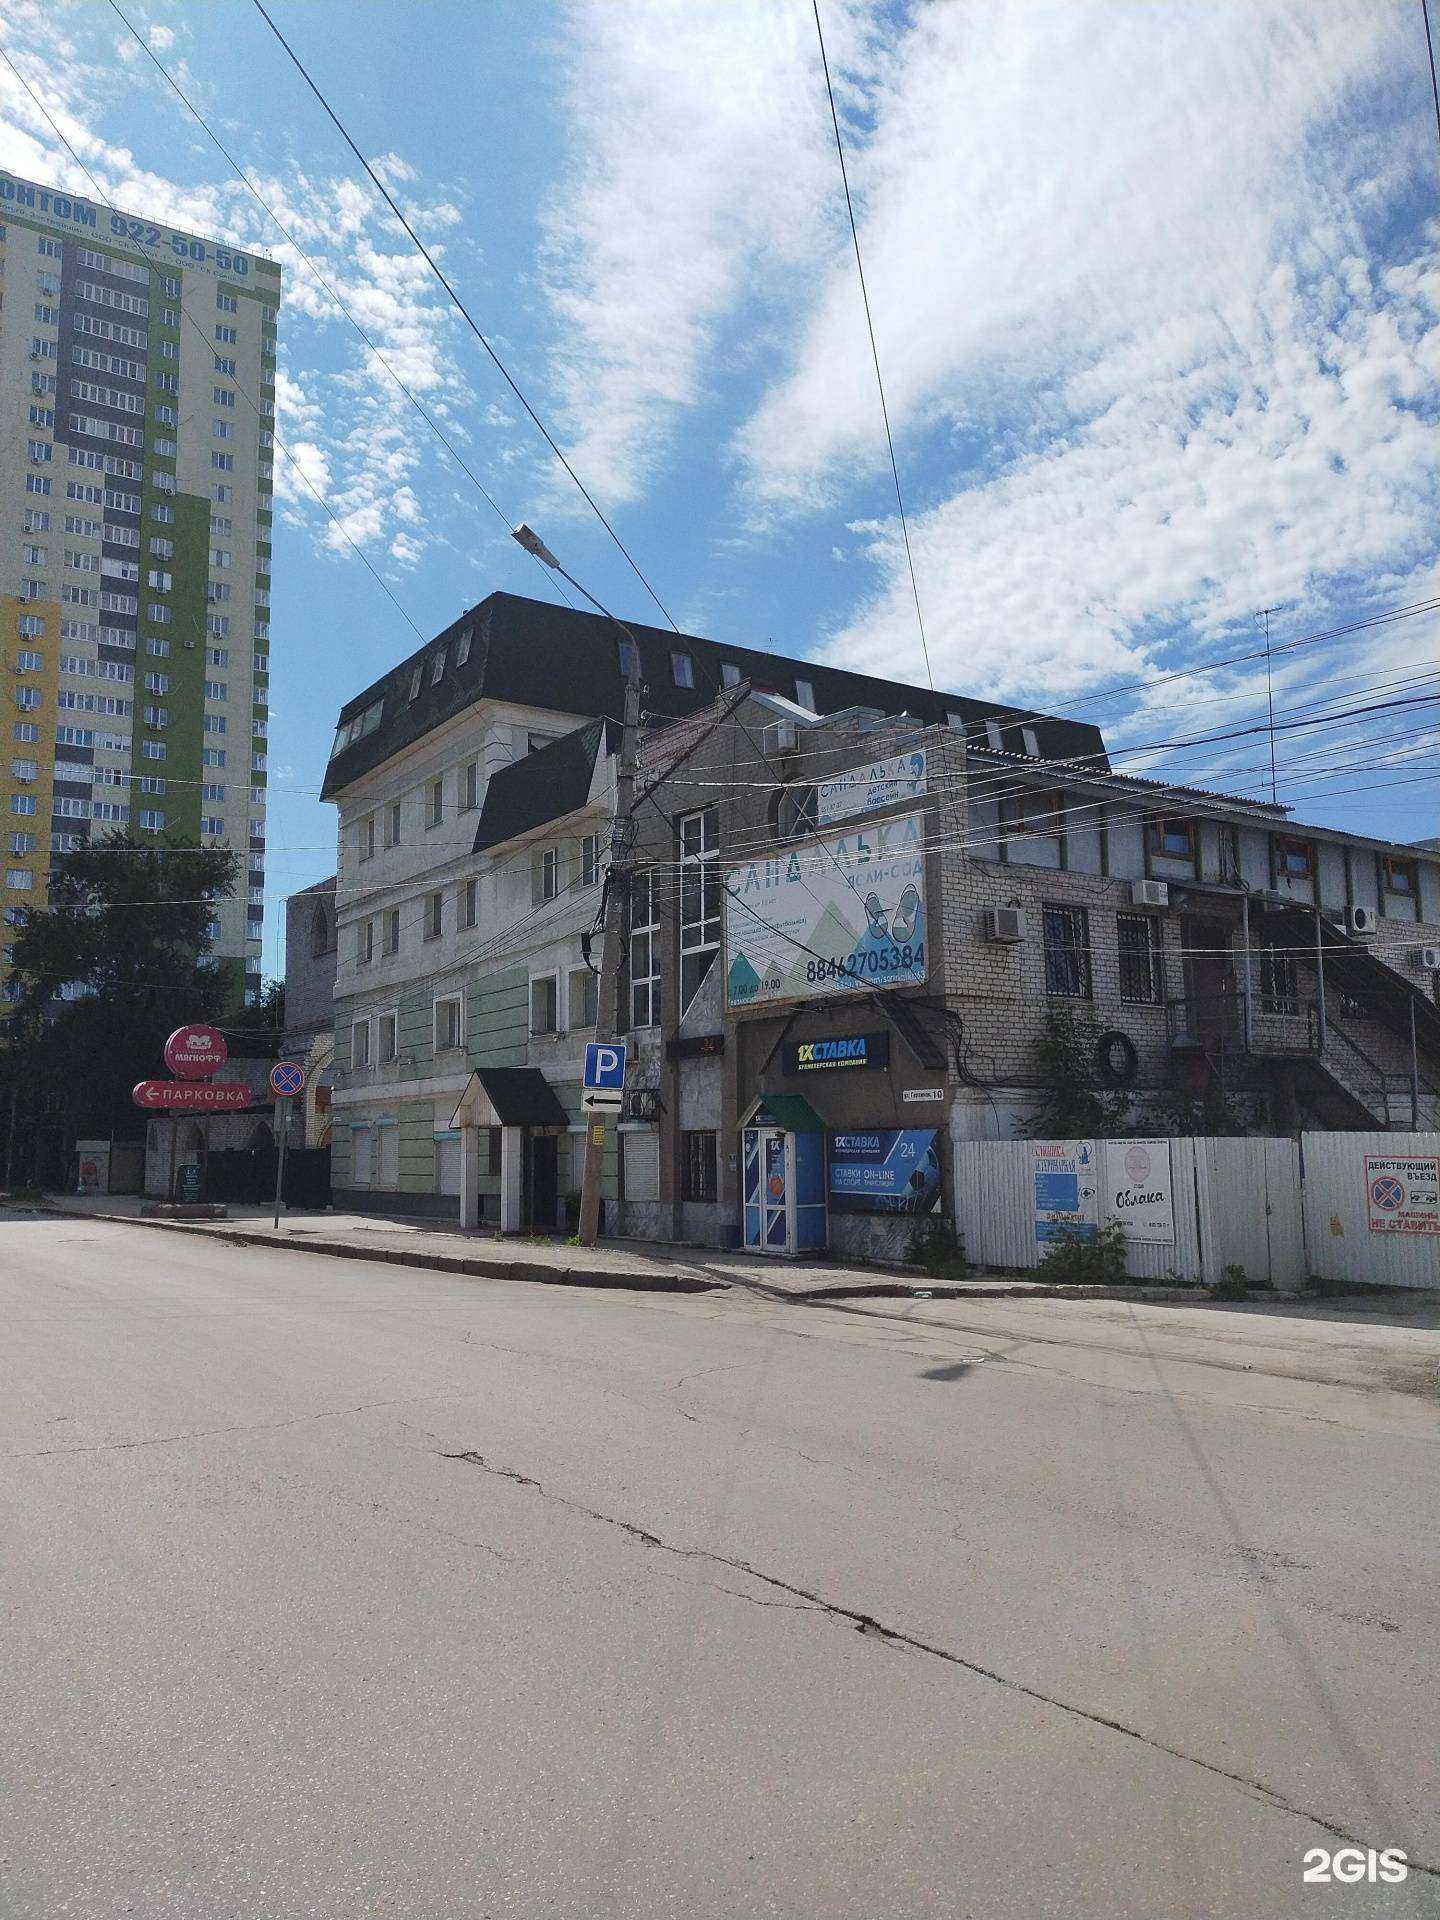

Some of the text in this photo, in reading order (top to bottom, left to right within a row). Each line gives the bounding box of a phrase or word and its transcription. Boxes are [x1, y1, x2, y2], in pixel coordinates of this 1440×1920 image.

[110, 214, 248, 276] 922-50-50
[595, 1048, 619, 1085] P
[163, 1089, 245, 1102] ПАРКОВКА
[900, 1142, 916, 1158] 24
[863, 1169, 895, 1181] ON-LINE
[1407, 1173, 1437, 1182] ВЪЕЗД
[1371, 1218, 1386, 1229] НЕ
